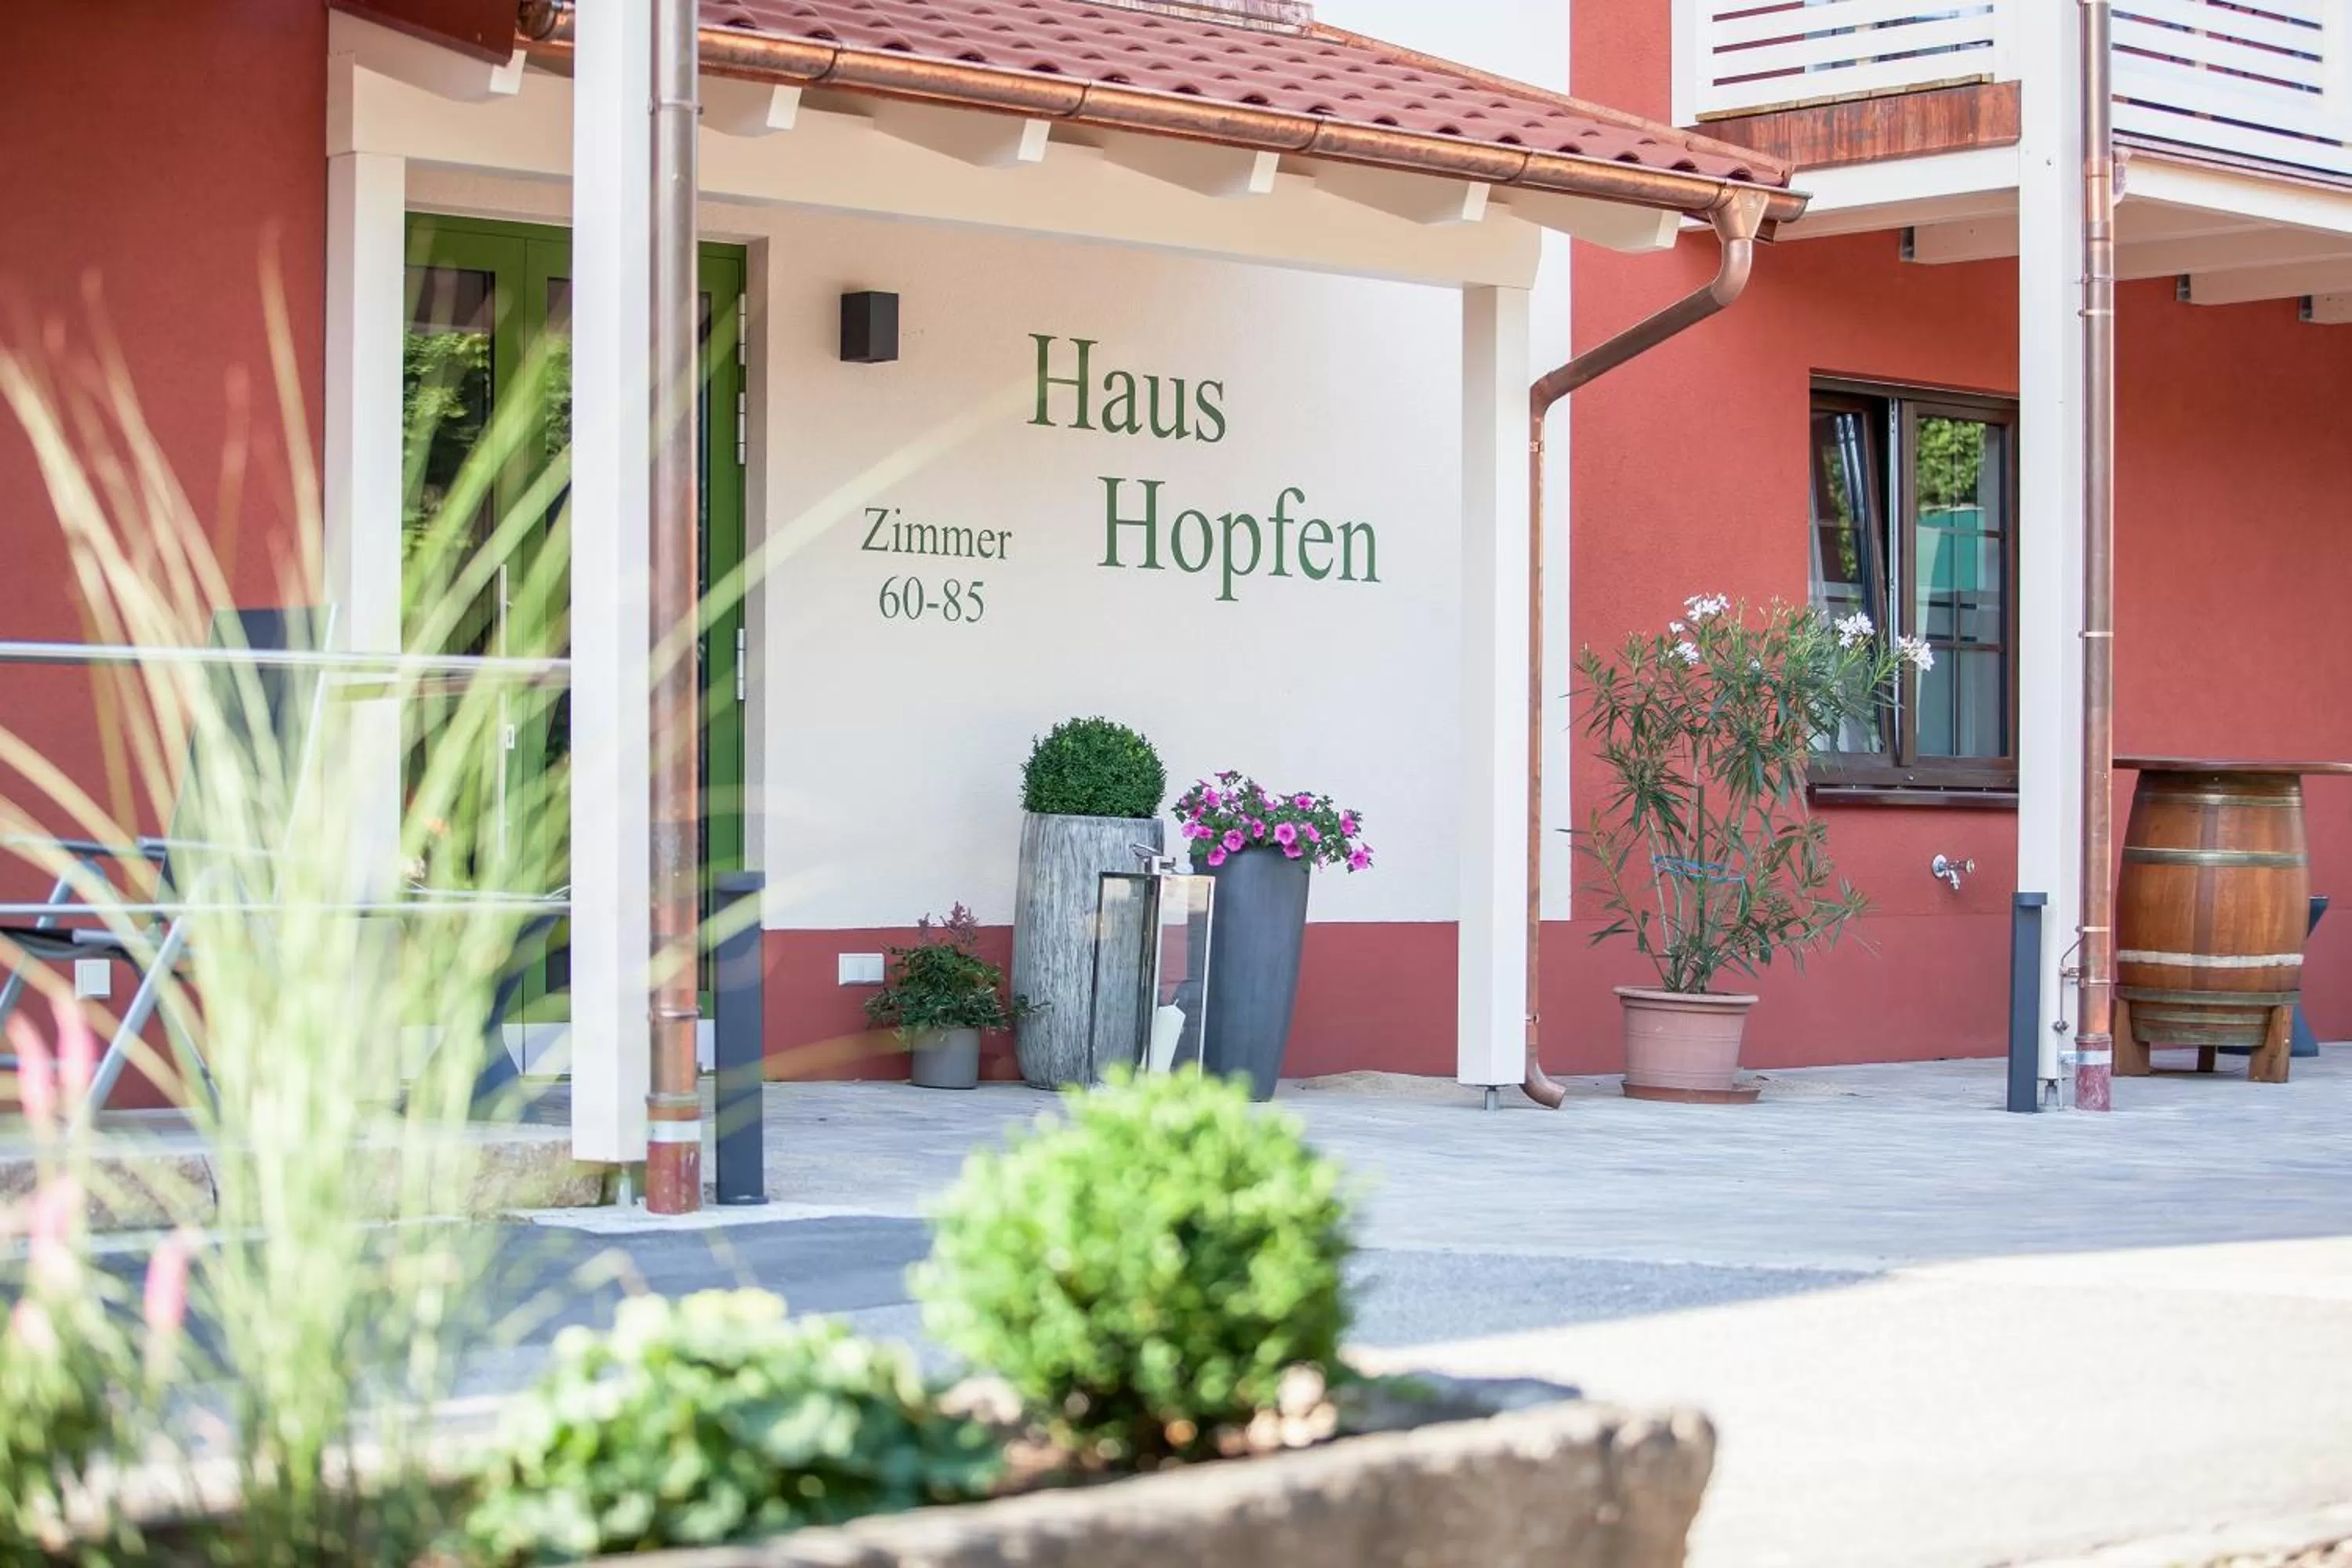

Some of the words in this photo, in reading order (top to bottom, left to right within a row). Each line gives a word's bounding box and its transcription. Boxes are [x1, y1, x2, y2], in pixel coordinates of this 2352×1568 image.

[1026, 332, 1227, 443] Haus
[861, 507, 1013, 561] Zimmer
[1098, 476, 1381, 602] Hopfen
[879, 575, 985, 623] 60-85
